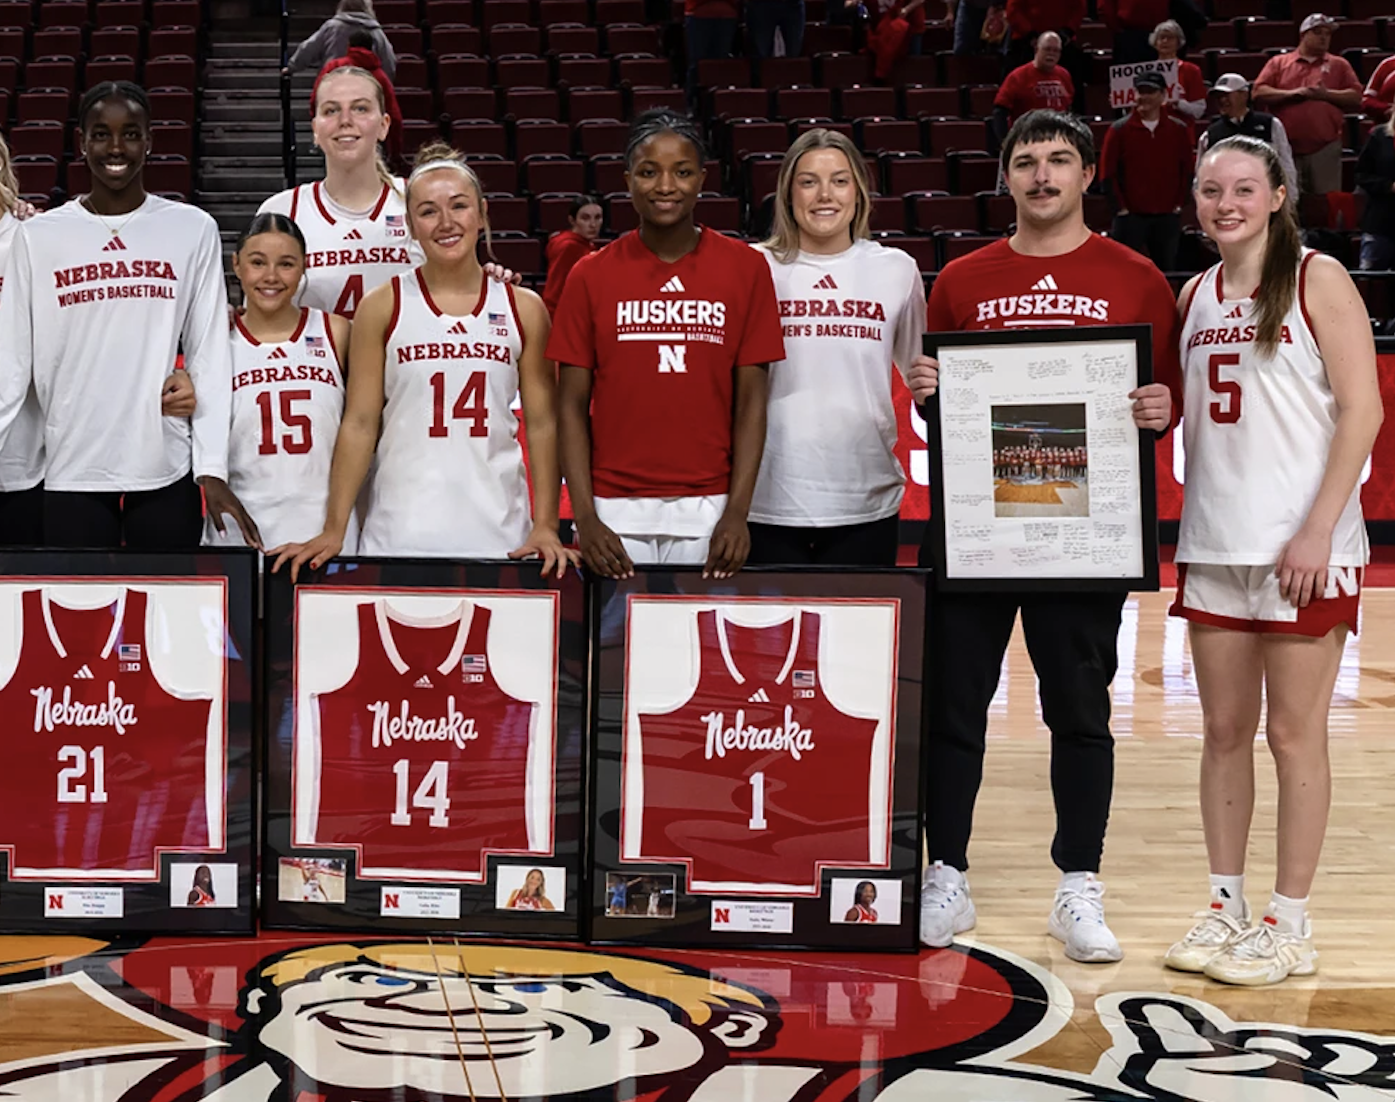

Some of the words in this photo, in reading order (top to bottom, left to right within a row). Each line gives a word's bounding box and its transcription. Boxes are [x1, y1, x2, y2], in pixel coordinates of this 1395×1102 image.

[1112, 84, 1175, 106] HAY
[54, 260, 179, 289] NEBRASKA
[58, 287, 105, 308] WOMEN'S
[107, 284, 176, 299] BASKETBALL
[333, 274, 363, 320] 4
[779, 299, 886, 322] EBRASKA
[975, 293, 1110, 322] HUSKERS
[616, 299, 726, 328] HUSKERS
[816, 324, 883, 342] BASKETBALL
[397, 342, 511, 365] NEBRASKA
[658, 345, 688, 373] N
[1209, 353, 1242, 424] 5
[429, 371, 489, 438] 14
[256, 389, 313, 455] 15
[30, 680, 139, 735] Nebraska
[367, 695, 479, 750] Nebraska
[700, 704, 816, 761] Nebraska
[57, 745, 108, 803] 21
[390, 759, 451, 828] 14
[748, 772, 768, 831] 1
[48, 894, 64, 910] N
[384, 893, 400, 909] N
[714, 908, 730, 924] N
